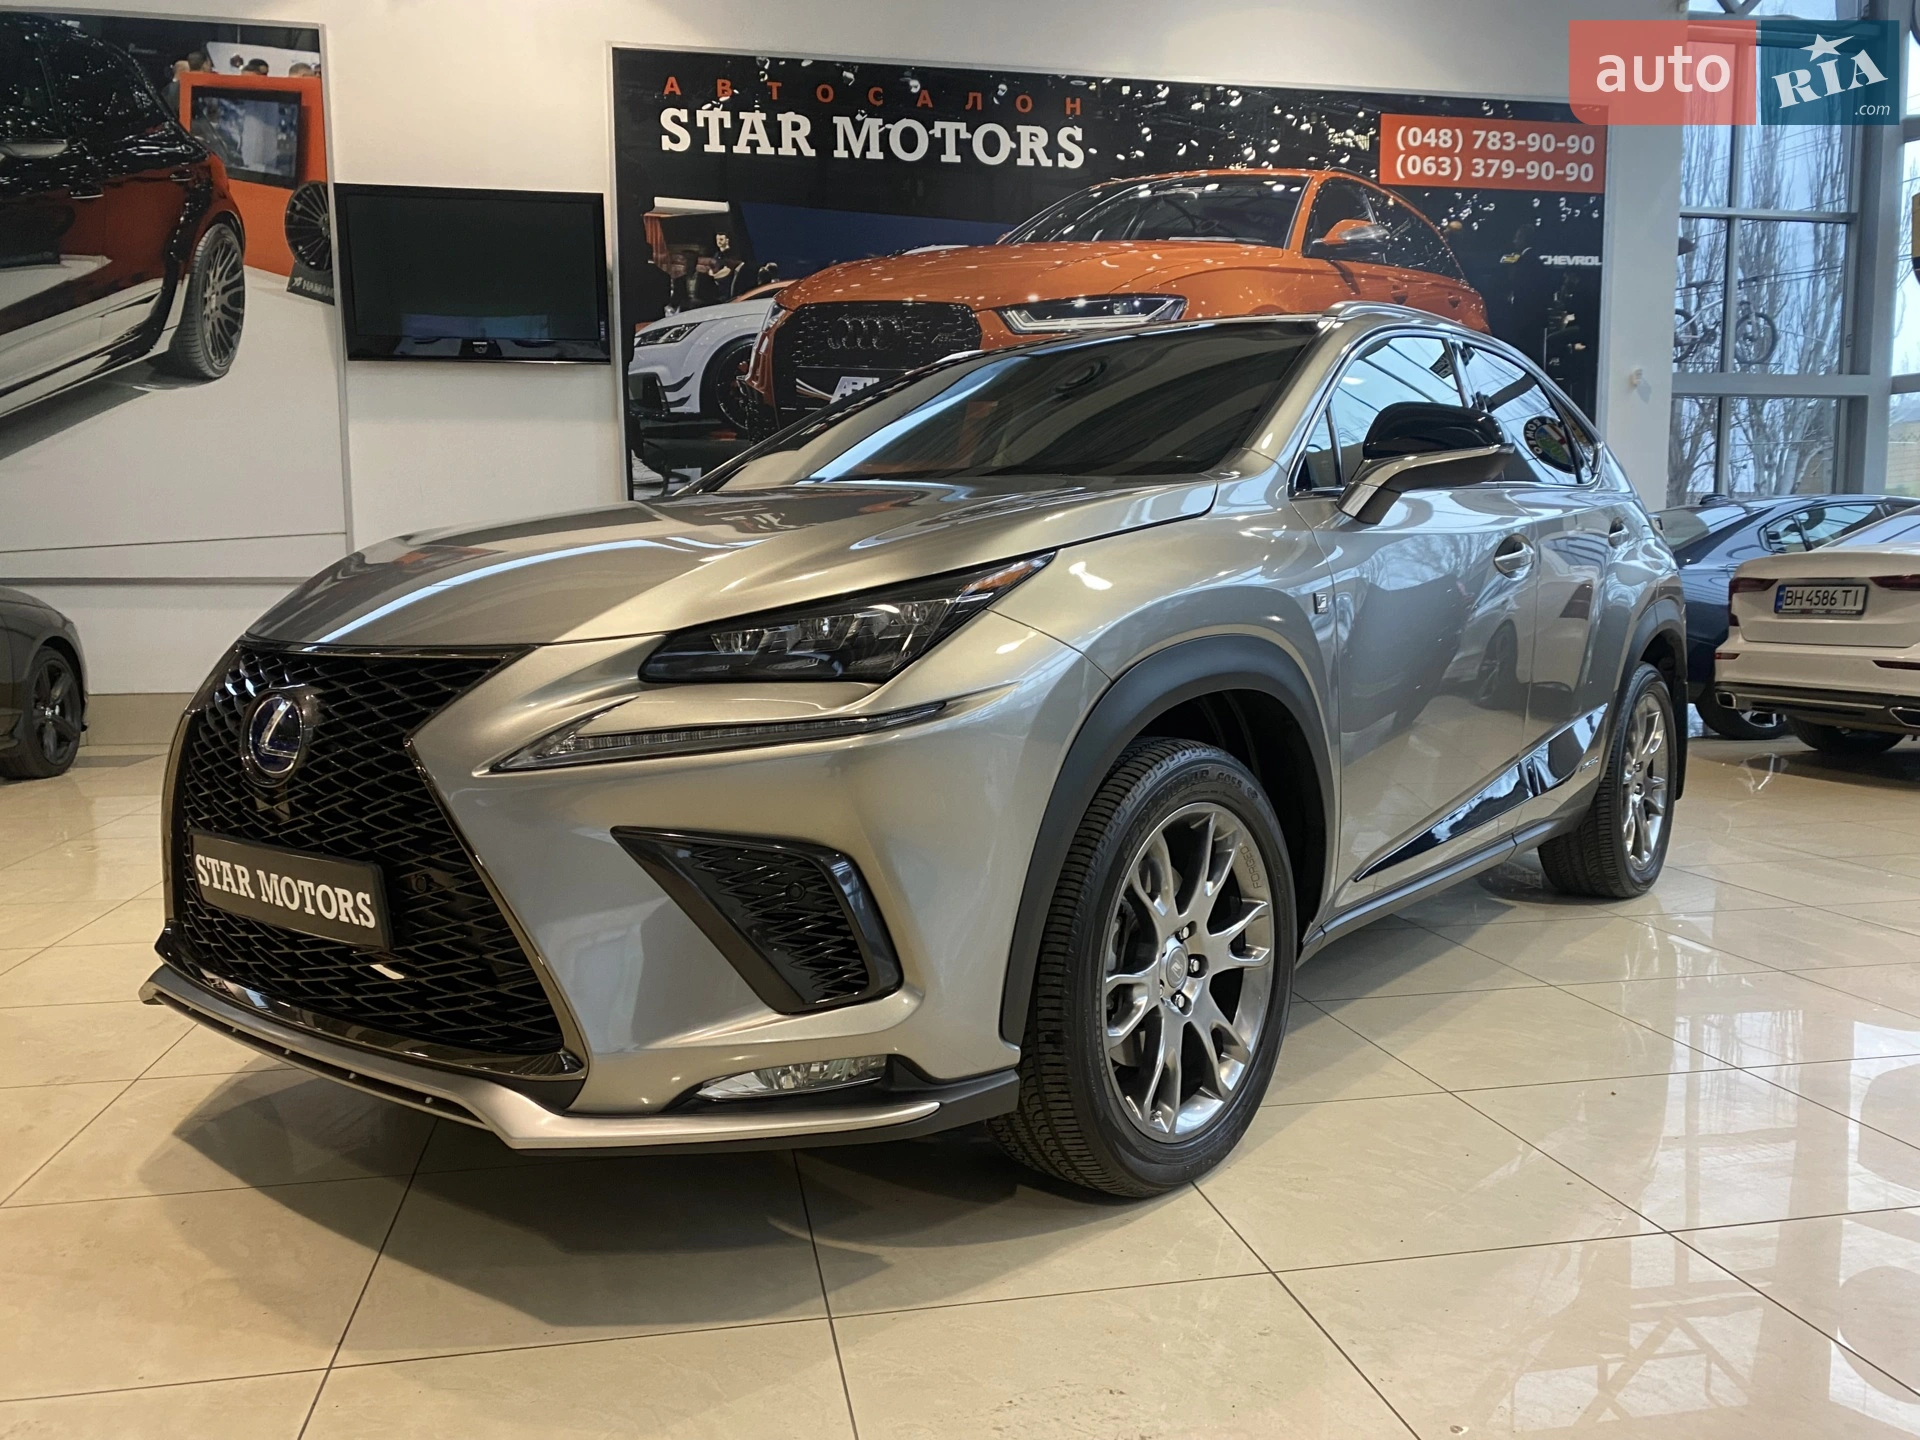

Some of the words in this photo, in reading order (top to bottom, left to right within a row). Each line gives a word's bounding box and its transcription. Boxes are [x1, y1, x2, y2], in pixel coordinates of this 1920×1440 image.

[660, 107, 816, 157] STAR
[833, 115, 1086, 169] MOTORS
[1396, 126, 1463, 151] (048)
[1472, 129, 1595, 155] 783-90-90
[1396, 154, 1463, 180] (063)
[1471, 157, 1594, 182] 379-90-90
[1784, 589, 1805, 606] BH
[1805, 589, 1838, 606] 4586
[1842, 589, 1859, 606] TI
[1240, 845, 1262, 889] FORGED
[194, 853, 256, 900] STAR
[257, 868, 377, 930] MOTORS
